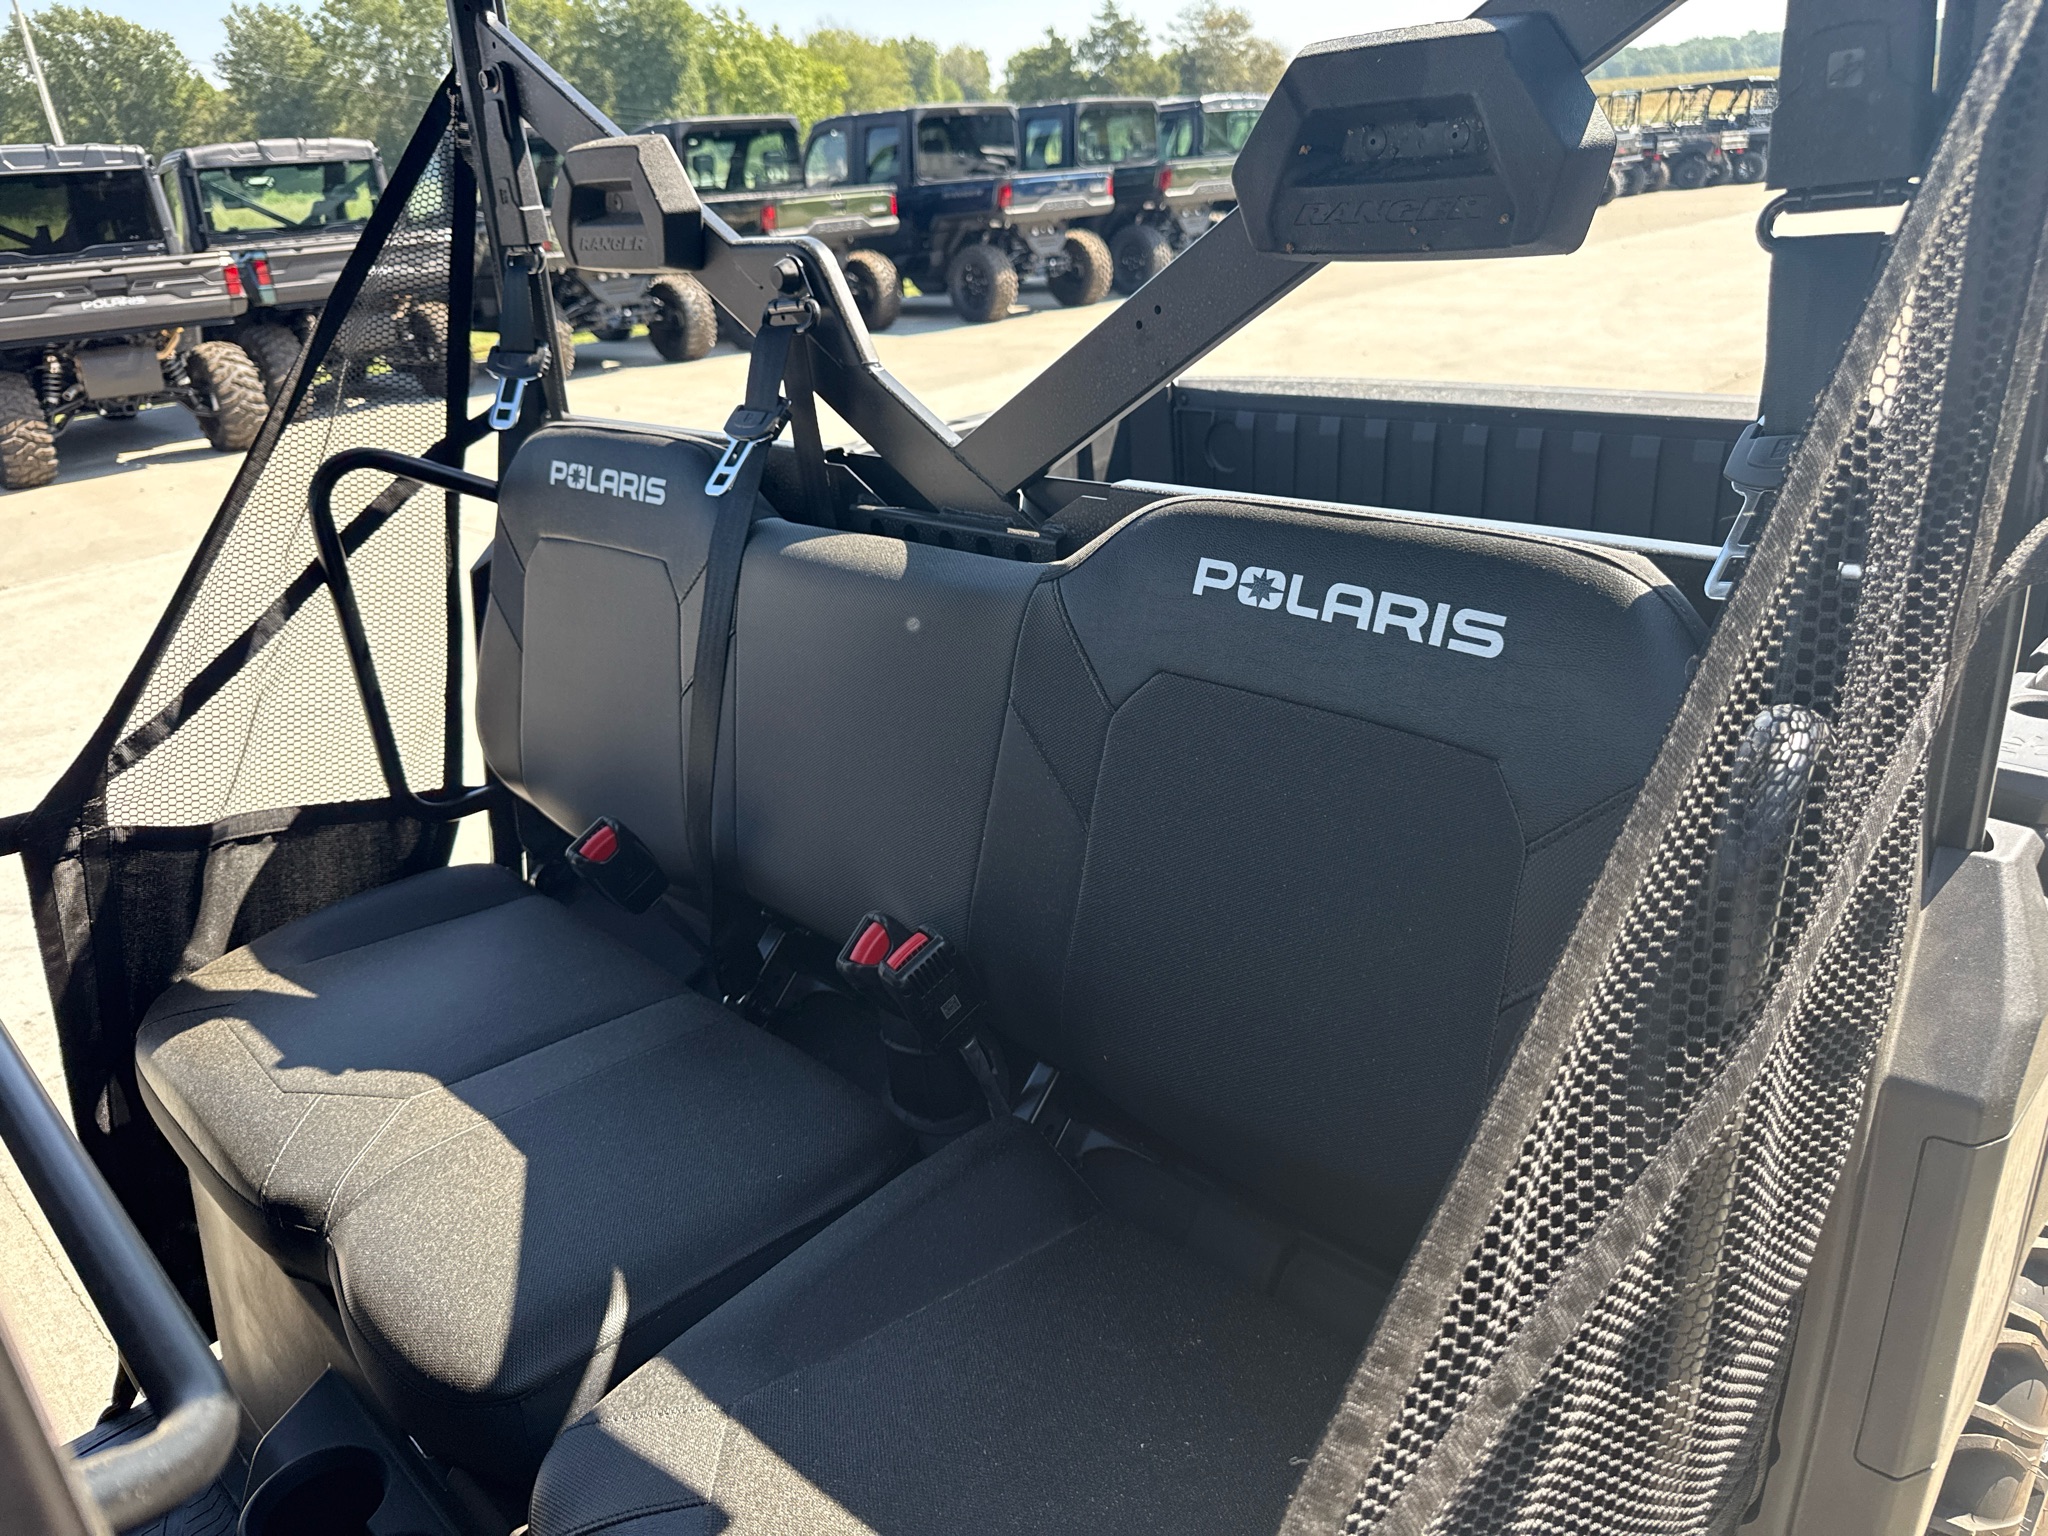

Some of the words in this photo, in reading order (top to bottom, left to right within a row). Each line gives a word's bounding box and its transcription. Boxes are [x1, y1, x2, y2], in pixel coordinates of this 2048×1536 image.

[1293, 194, 1489, 226] RANGER
[579, 236, 647, 252] RANGER
[81, 295, 147, 310] POLARIS
[549, 460, 667, 506] POLARIS
[1192, 557, 1508, 659] POLARIS
